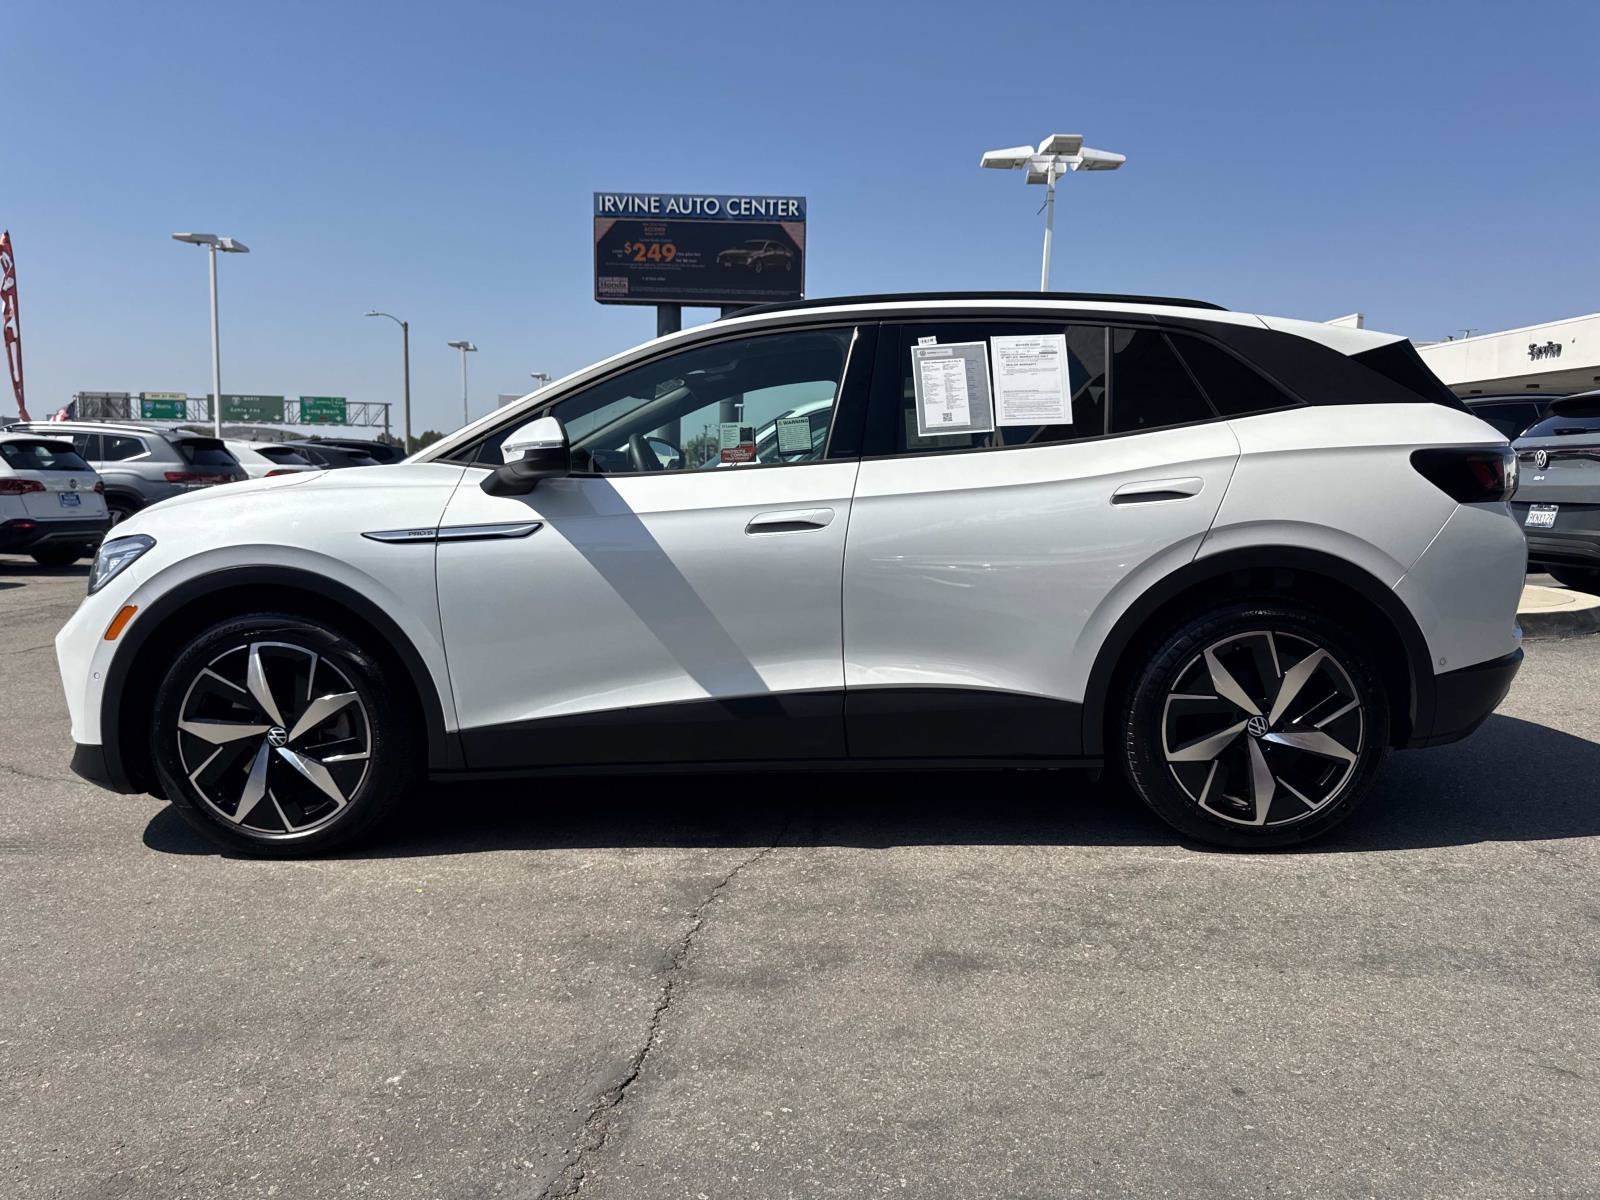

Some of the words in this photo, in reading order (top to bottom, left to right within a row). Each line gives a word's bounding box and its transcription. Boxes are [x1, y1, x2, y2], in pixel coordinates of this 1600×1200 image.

[599, 195, 660, 213] IRVINE
[666, 197, 720, 215] AUTO
[726, 198, 799, 217] CENTER
[624, 242, 677, 262] $249
[783, 418, 809, 426] WARNING
